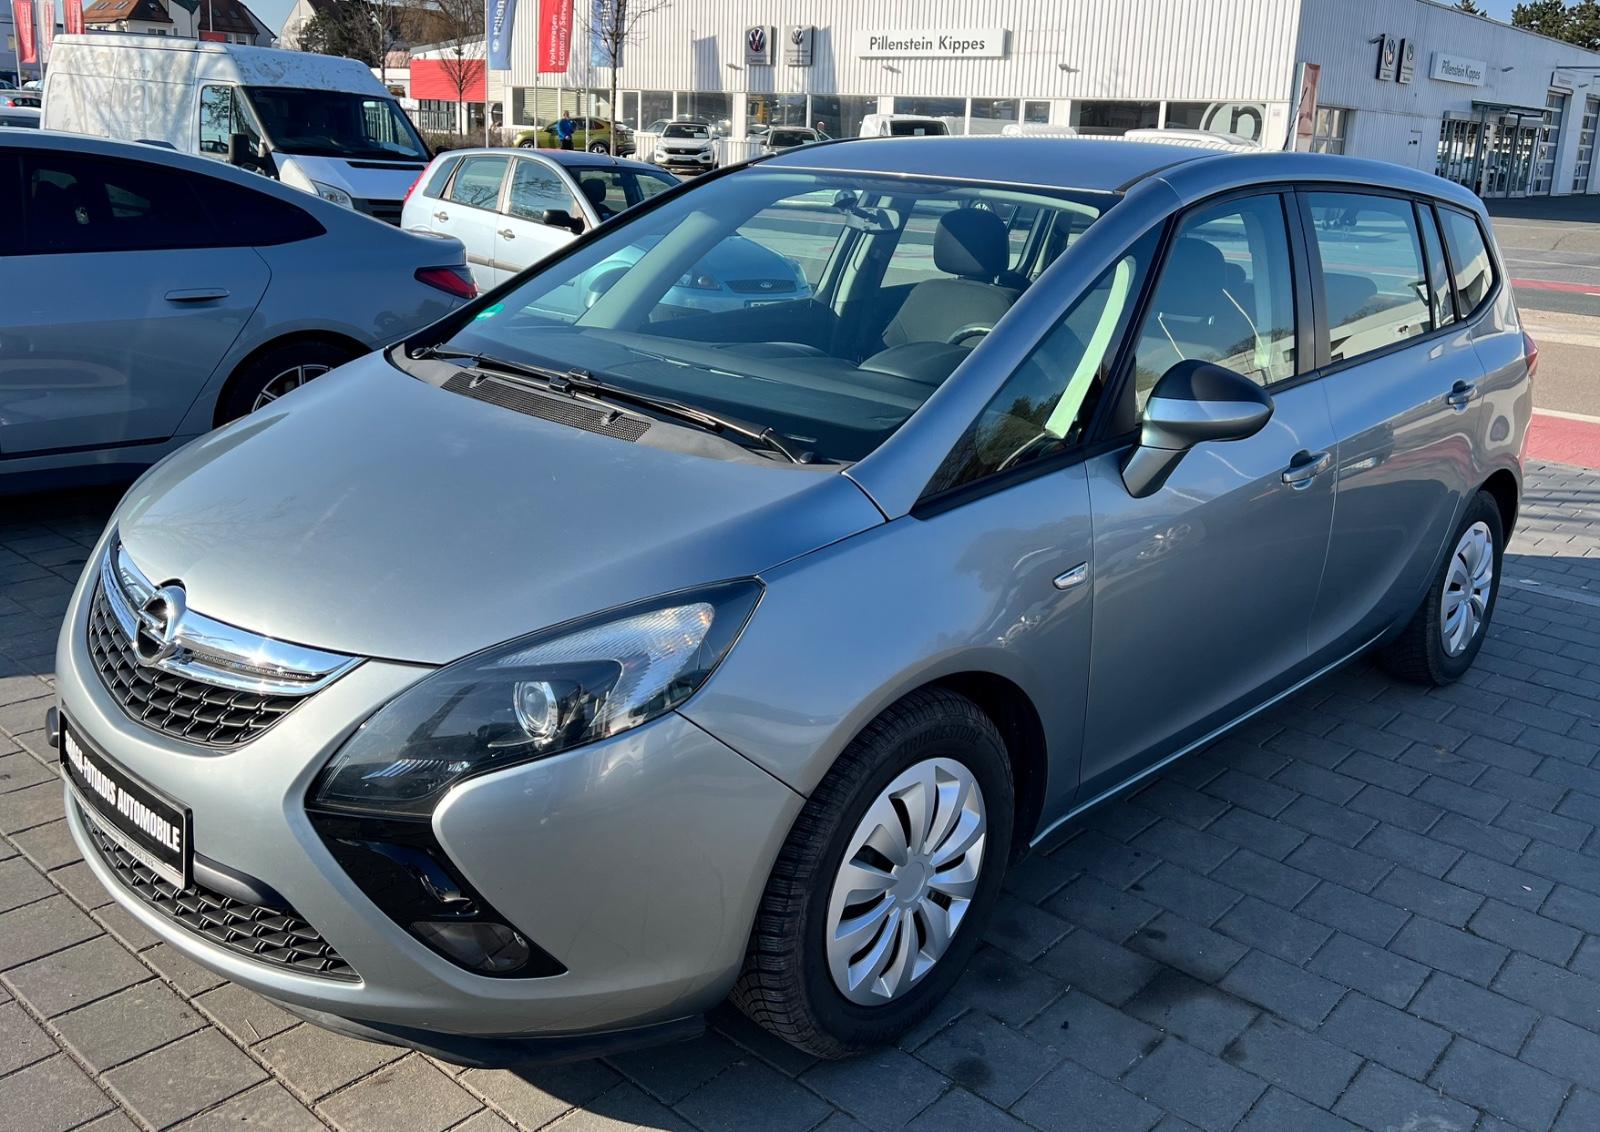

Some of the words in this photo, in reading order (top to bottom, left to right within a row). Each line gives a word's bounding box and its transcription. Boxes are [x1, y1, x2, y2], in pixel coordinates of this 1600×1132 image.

[550, 14, 558, 66] Volkswagen
[558, 27, 567, 66] Economy
[869, 35, 933, 51] Pillenstein
[938, 35, 985, 54] Kippes
[1464, 63, 1481, 82] Kippes
[117, 787, 180, 853] AUTOMOBILE
